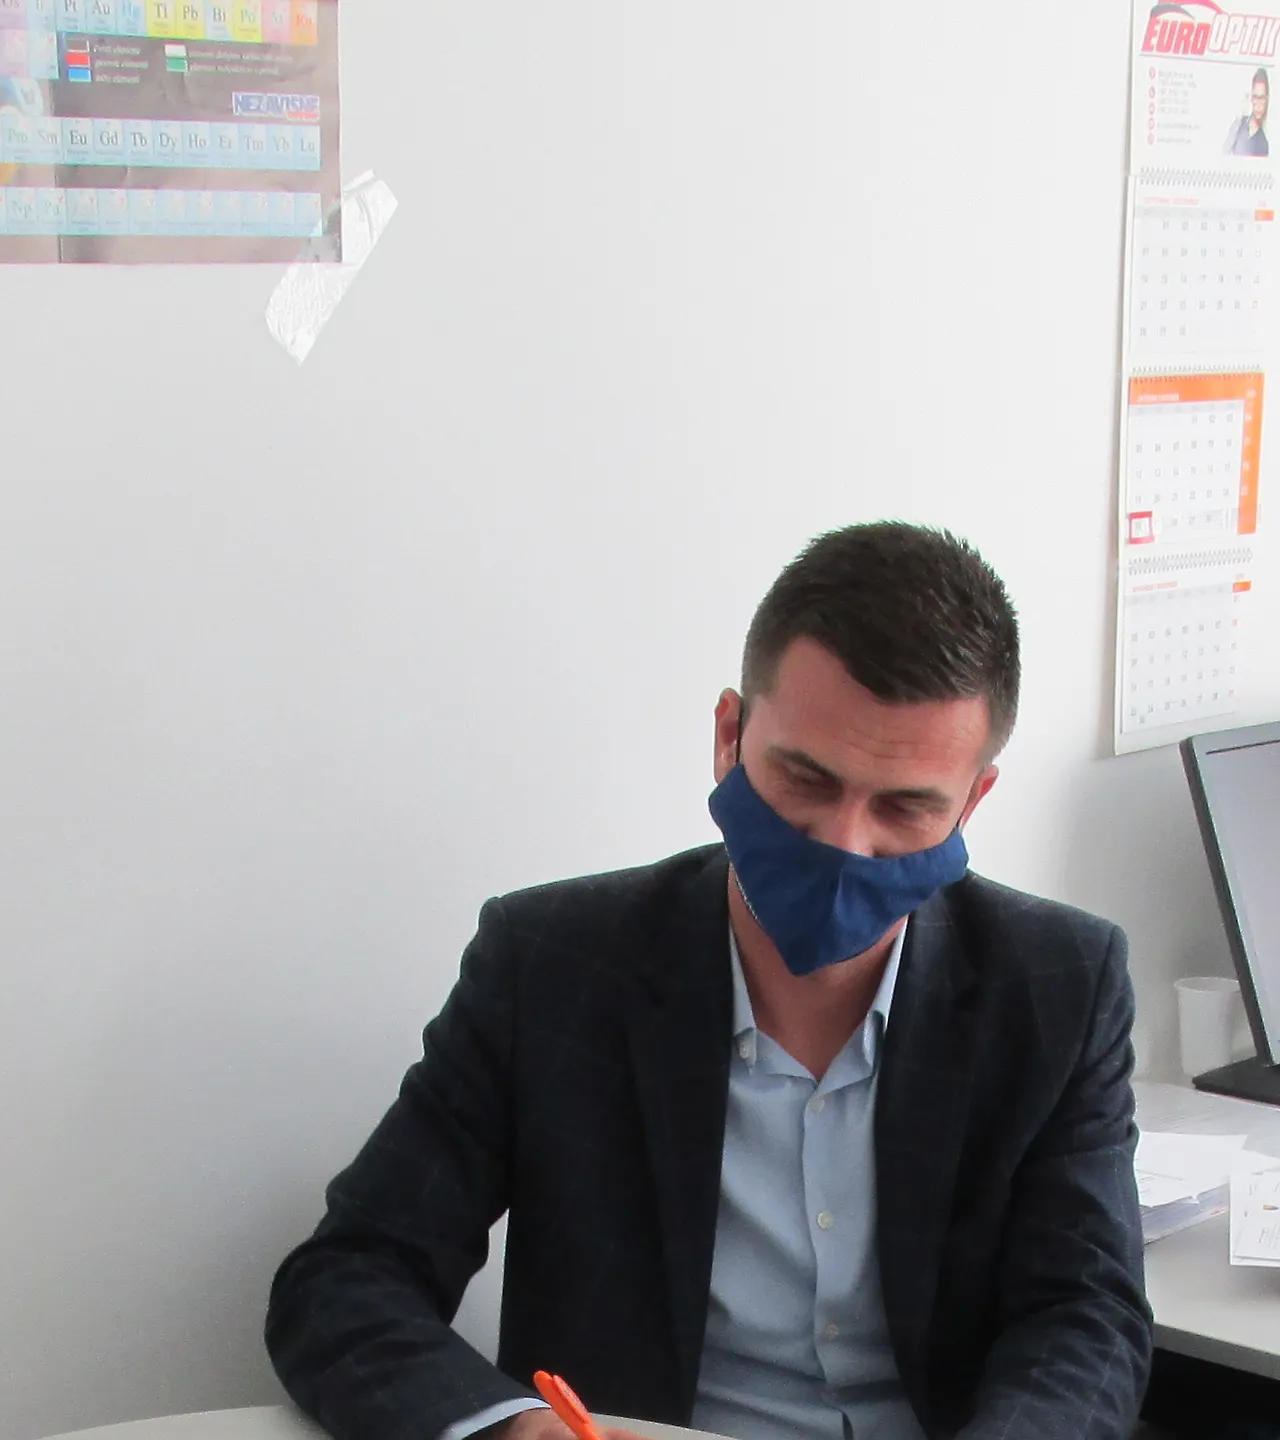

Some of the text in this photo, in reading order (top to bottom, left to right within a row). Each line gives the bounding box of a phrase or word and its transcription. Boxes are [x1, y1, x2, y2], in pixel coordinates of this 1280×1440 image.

[182, 5, 199, 20] Pb
[70, 130, 87, 146] Eu
[99, 131, 119, 147] Gd
[130, 132, 148, 148] Tb
[158, 133, 177, 151] Dy
[188, 134, 207, 149] Ho
